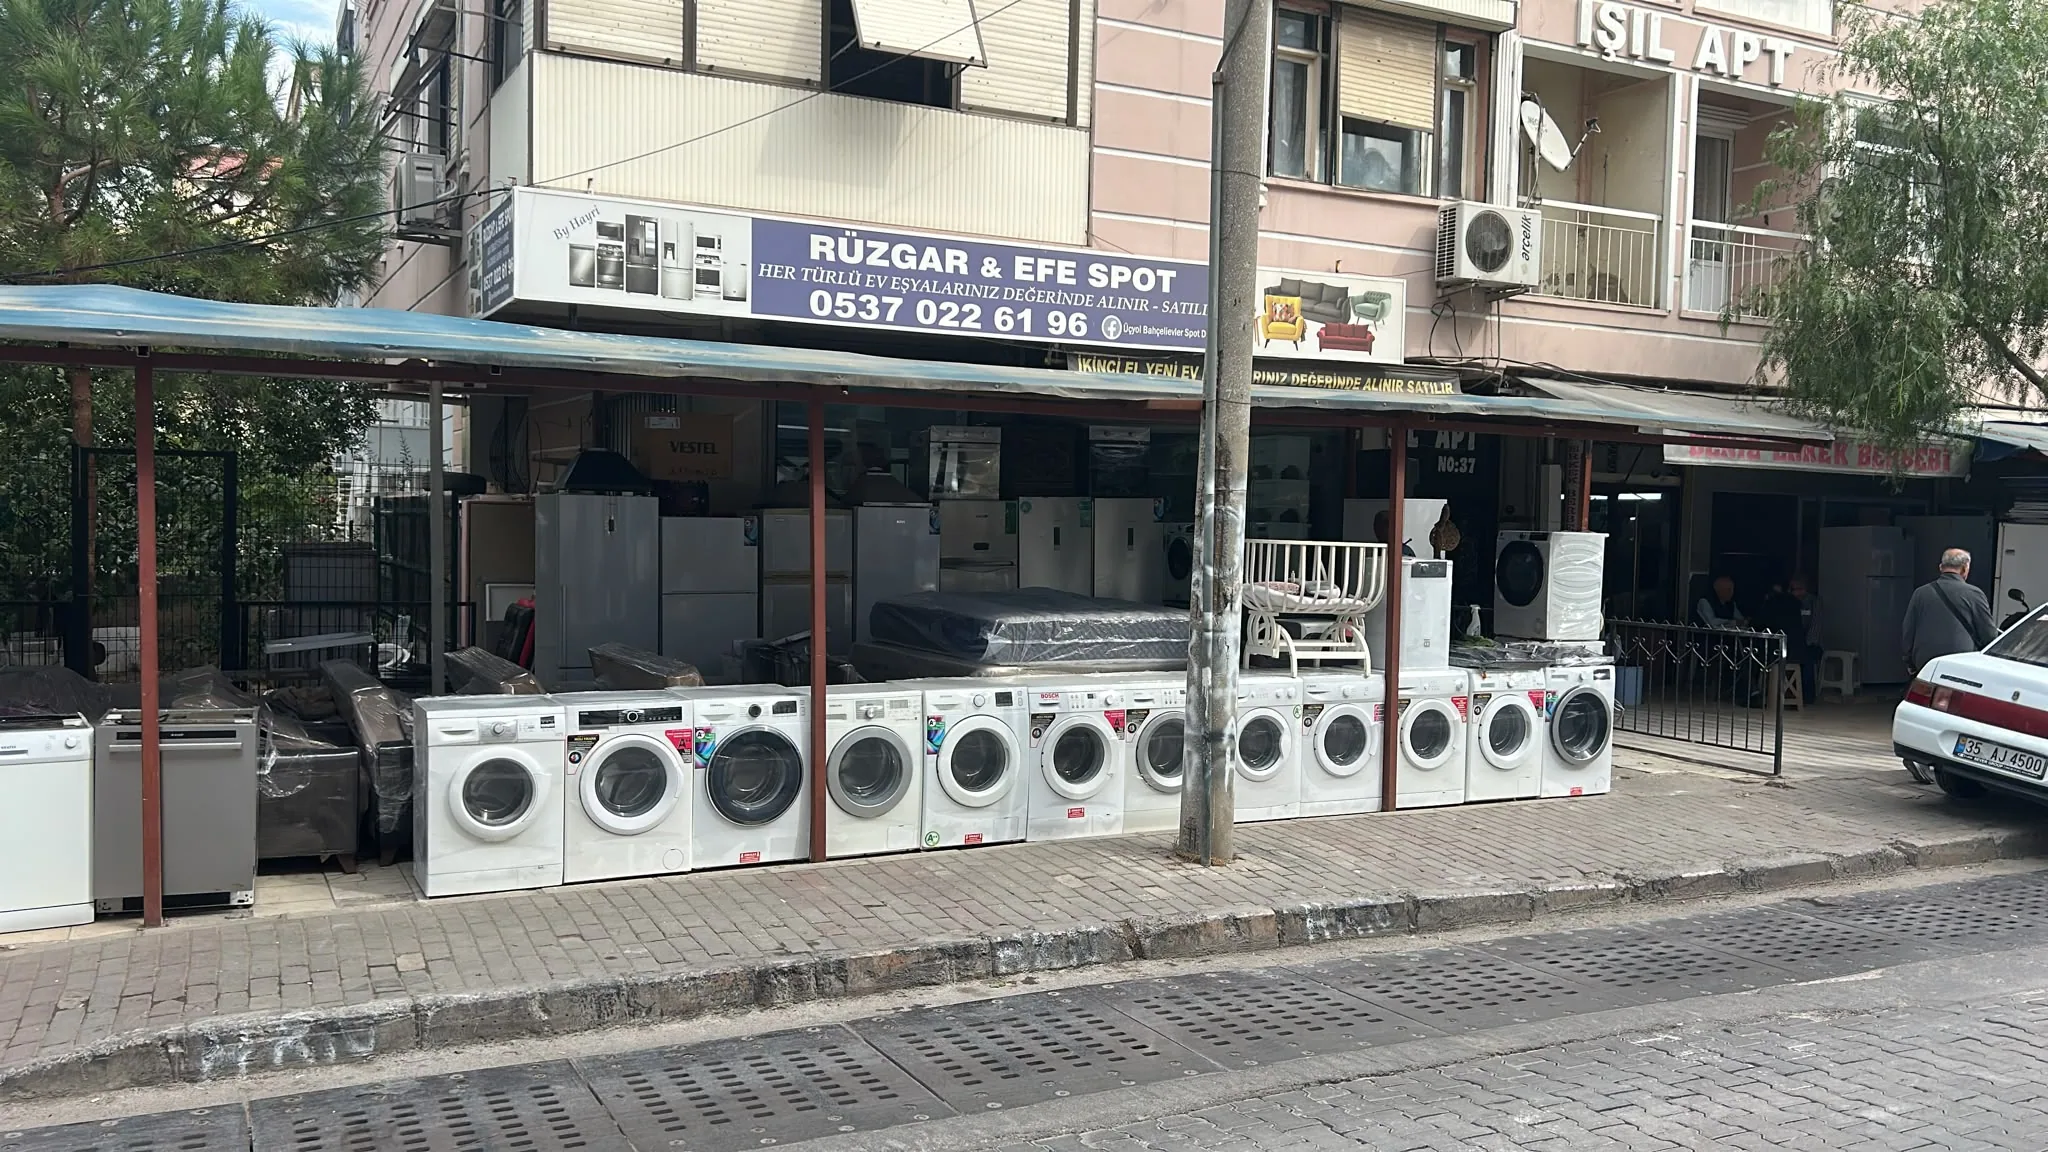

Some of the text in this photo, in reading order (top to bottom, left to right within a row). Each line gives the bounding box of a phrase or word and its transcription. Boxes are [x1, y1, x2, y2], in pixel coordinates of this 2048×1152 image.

[1577, 0, 1796, 86] IŞIL APT
[553, 204, 600, 240] By Hayri
[1521, 214, 1533, 262] arçelik
[810, 230, 1177, 293] RÜZGAR & EFE SPOT
[758, 263, 796, 280] HER
[801, 266, 862, 287] TÜRLÜ
[865, 273, 889, 289] EV
[890, 276, 1000, 300] EŞYALARINIZ
[1002, 286, 1095, 307] DEĞERİNDE
[1096, 296, 1149, 312] ALINIR
[1161, 300, 1208, 316] SATILI
[810, 290, 1088, 337] 0537 022 61 96
[1184, 327, 1200, 338] Spot
[1146, 360, 1178, 378] YENİ
[1181, 365, 1199, 380] EV
[1253, 371, 1287, 385] RINIZ
[1291, 371, 1361, 391] DEĞERİNDE
[1363, 377, 1404, 393] ALINIR
[1407, 380, 1454, 396] SATILIR
[668, 440, 719, 455] VESTEL
[1437, 455, 1476, 474] NO:37
[1965, 740, 1983, 755] 35
[1990, 747, 2008, 762] AJ
[2010, 753, 2042, 772] 4500
